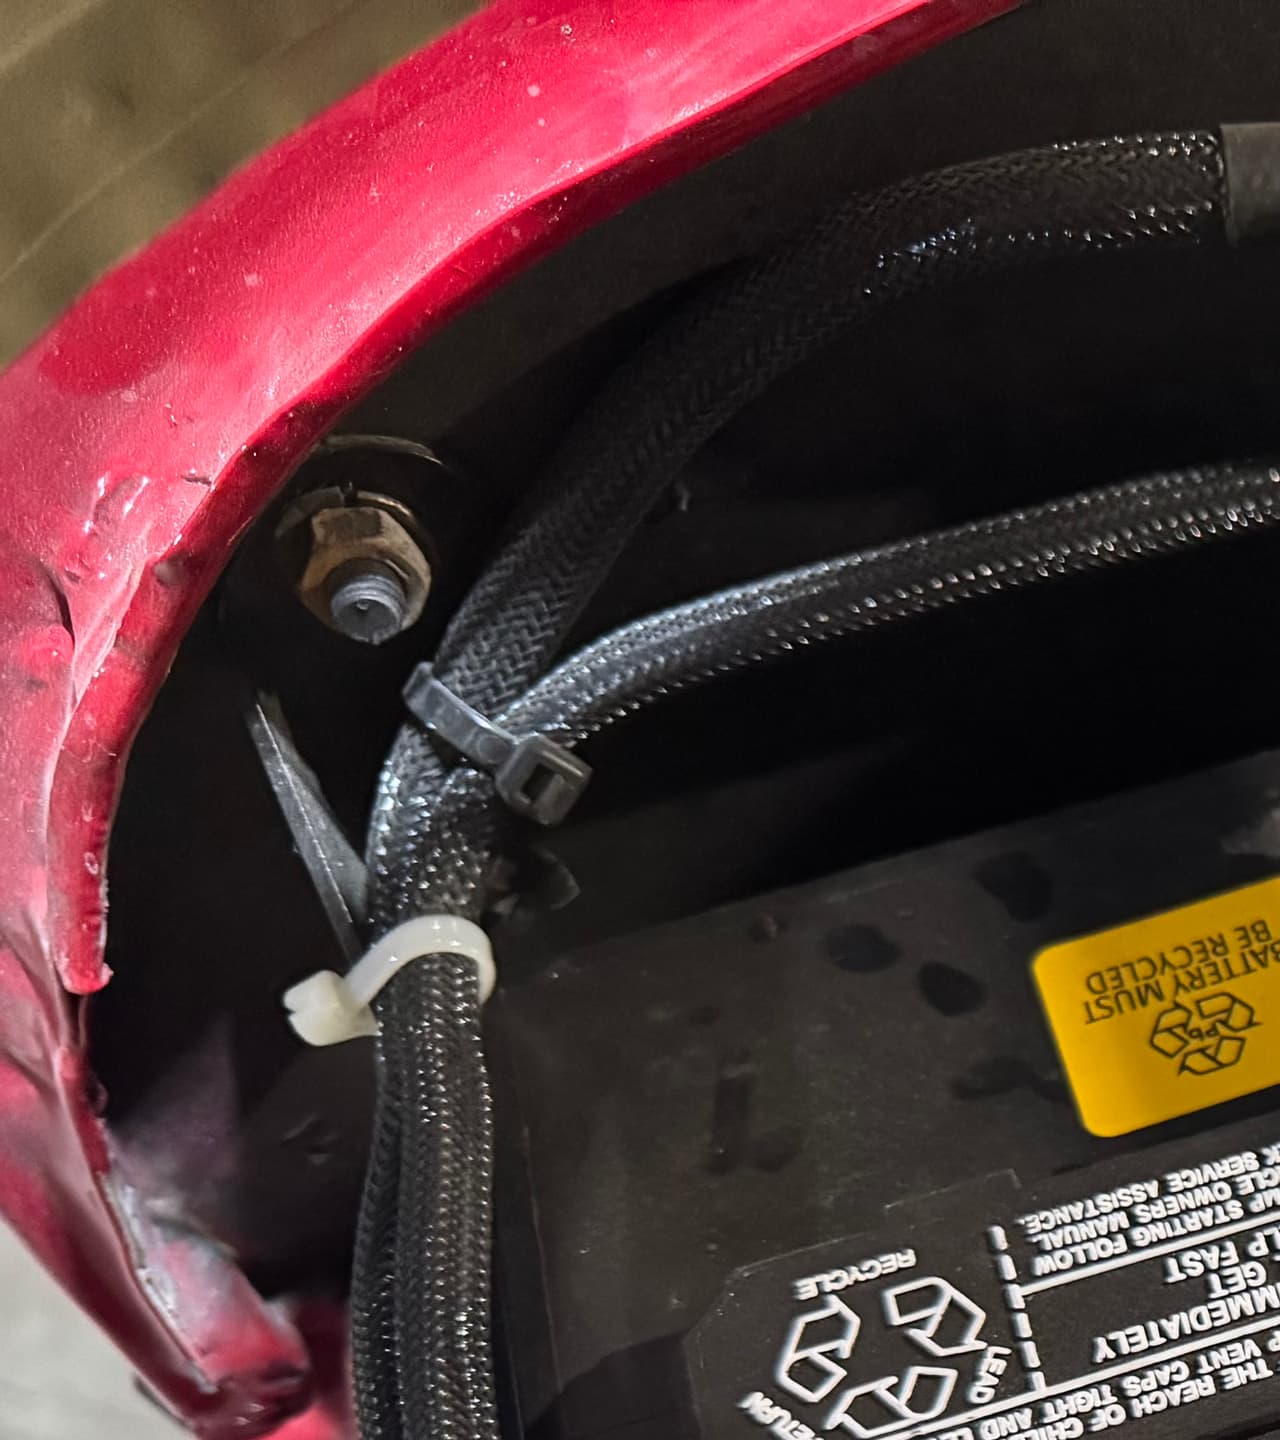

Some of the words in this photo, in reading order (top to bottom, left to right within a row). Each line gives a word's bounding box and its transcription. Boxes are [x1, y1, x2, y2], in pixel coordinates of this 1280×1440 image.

[1231, 918, 1272, 950] BE
[1083, 932, 1229, 997] RECYCLED
[1078, 977, 1165, 1024] MUST
[1186, 1022, 1219, 1044] Pb
[1162, 1147, 1260, 1195] SERVICE
[1012, 1175, 1162, 1239] ASSISTANCE.
[1127, 1195, 1244, 1250] STARTING
[1130, 1177, 1233, 1227] OWNERS
[1026, 1230, 1128, 1279] FOLLOW
[1029, 1207, 1130, 1257] MANUAL.
[792, 1249, 917, 1300] RECYCLE
[1157, 1237, 1240, 1284] FAST
[1201, 1257, 1268, 1300] GET
[966, 1345, 1012, 1404] LEAD
[1119, 1357, 1191, 1397] CAPS
[1192, 1335, 1262, 1375] VENT
[1216, 1355, 1272, 1390] THE
[1037, 1380, 1117, 1423] TIGHT
[1085, 1400, 1127, 1431] OF
[1128, 1373, 1216, 1418] REACH
